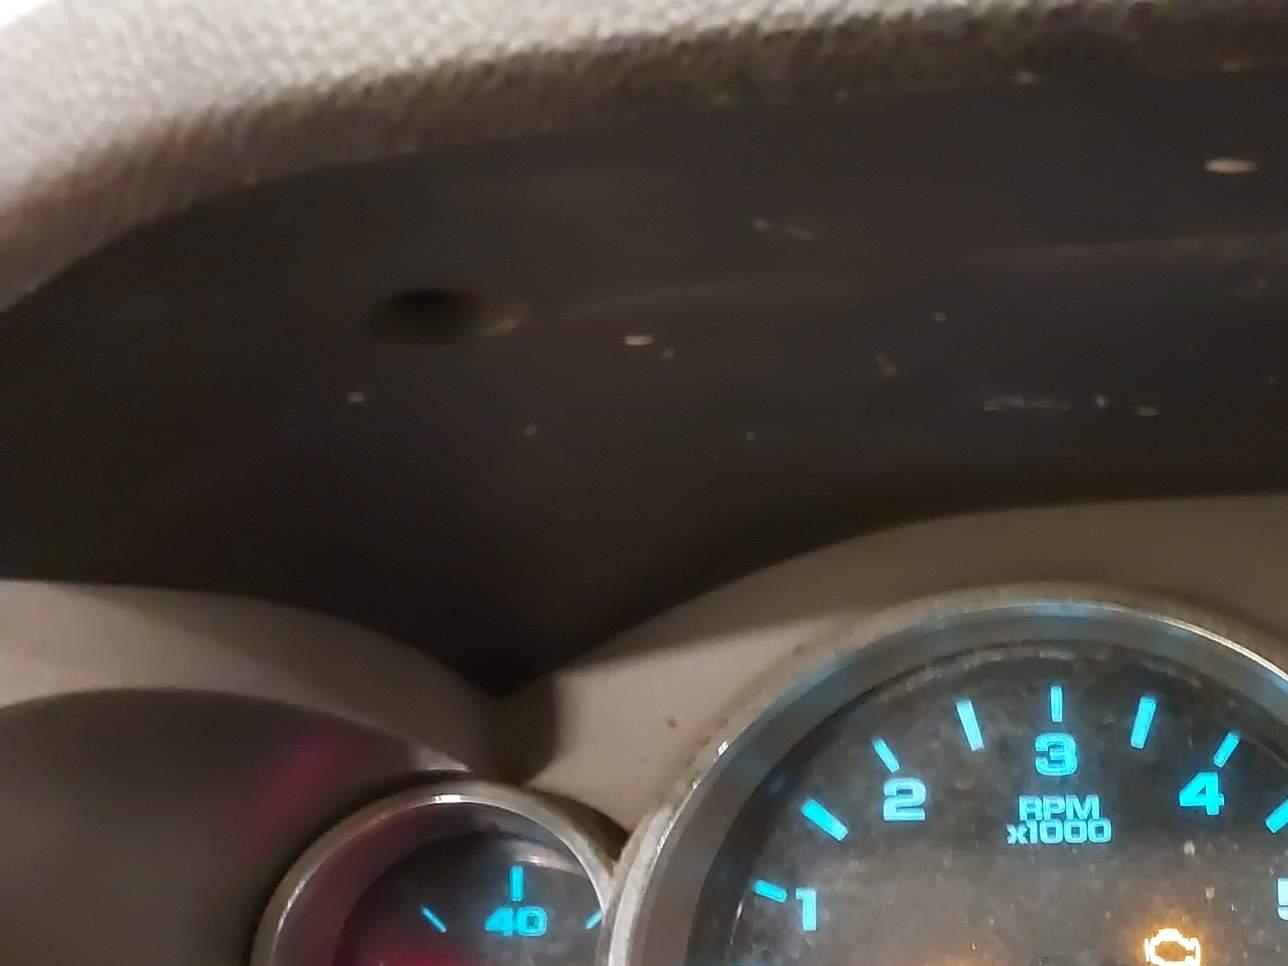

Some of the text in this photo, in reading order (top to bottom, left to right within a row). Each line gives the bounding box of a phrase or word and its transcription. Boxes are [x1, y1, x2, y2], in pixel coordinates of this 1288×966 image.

[1034, 731, 1079, 777] 3
[882, 776, 928, 823] 2
[1017, 794, 1101, 822] RPM
[1178, 770, 1226, 817] 4
[1006, 821, 1113, 846] x1000
[485, 905, 548, 937] 40
[796, 887, 818, 932] 1
